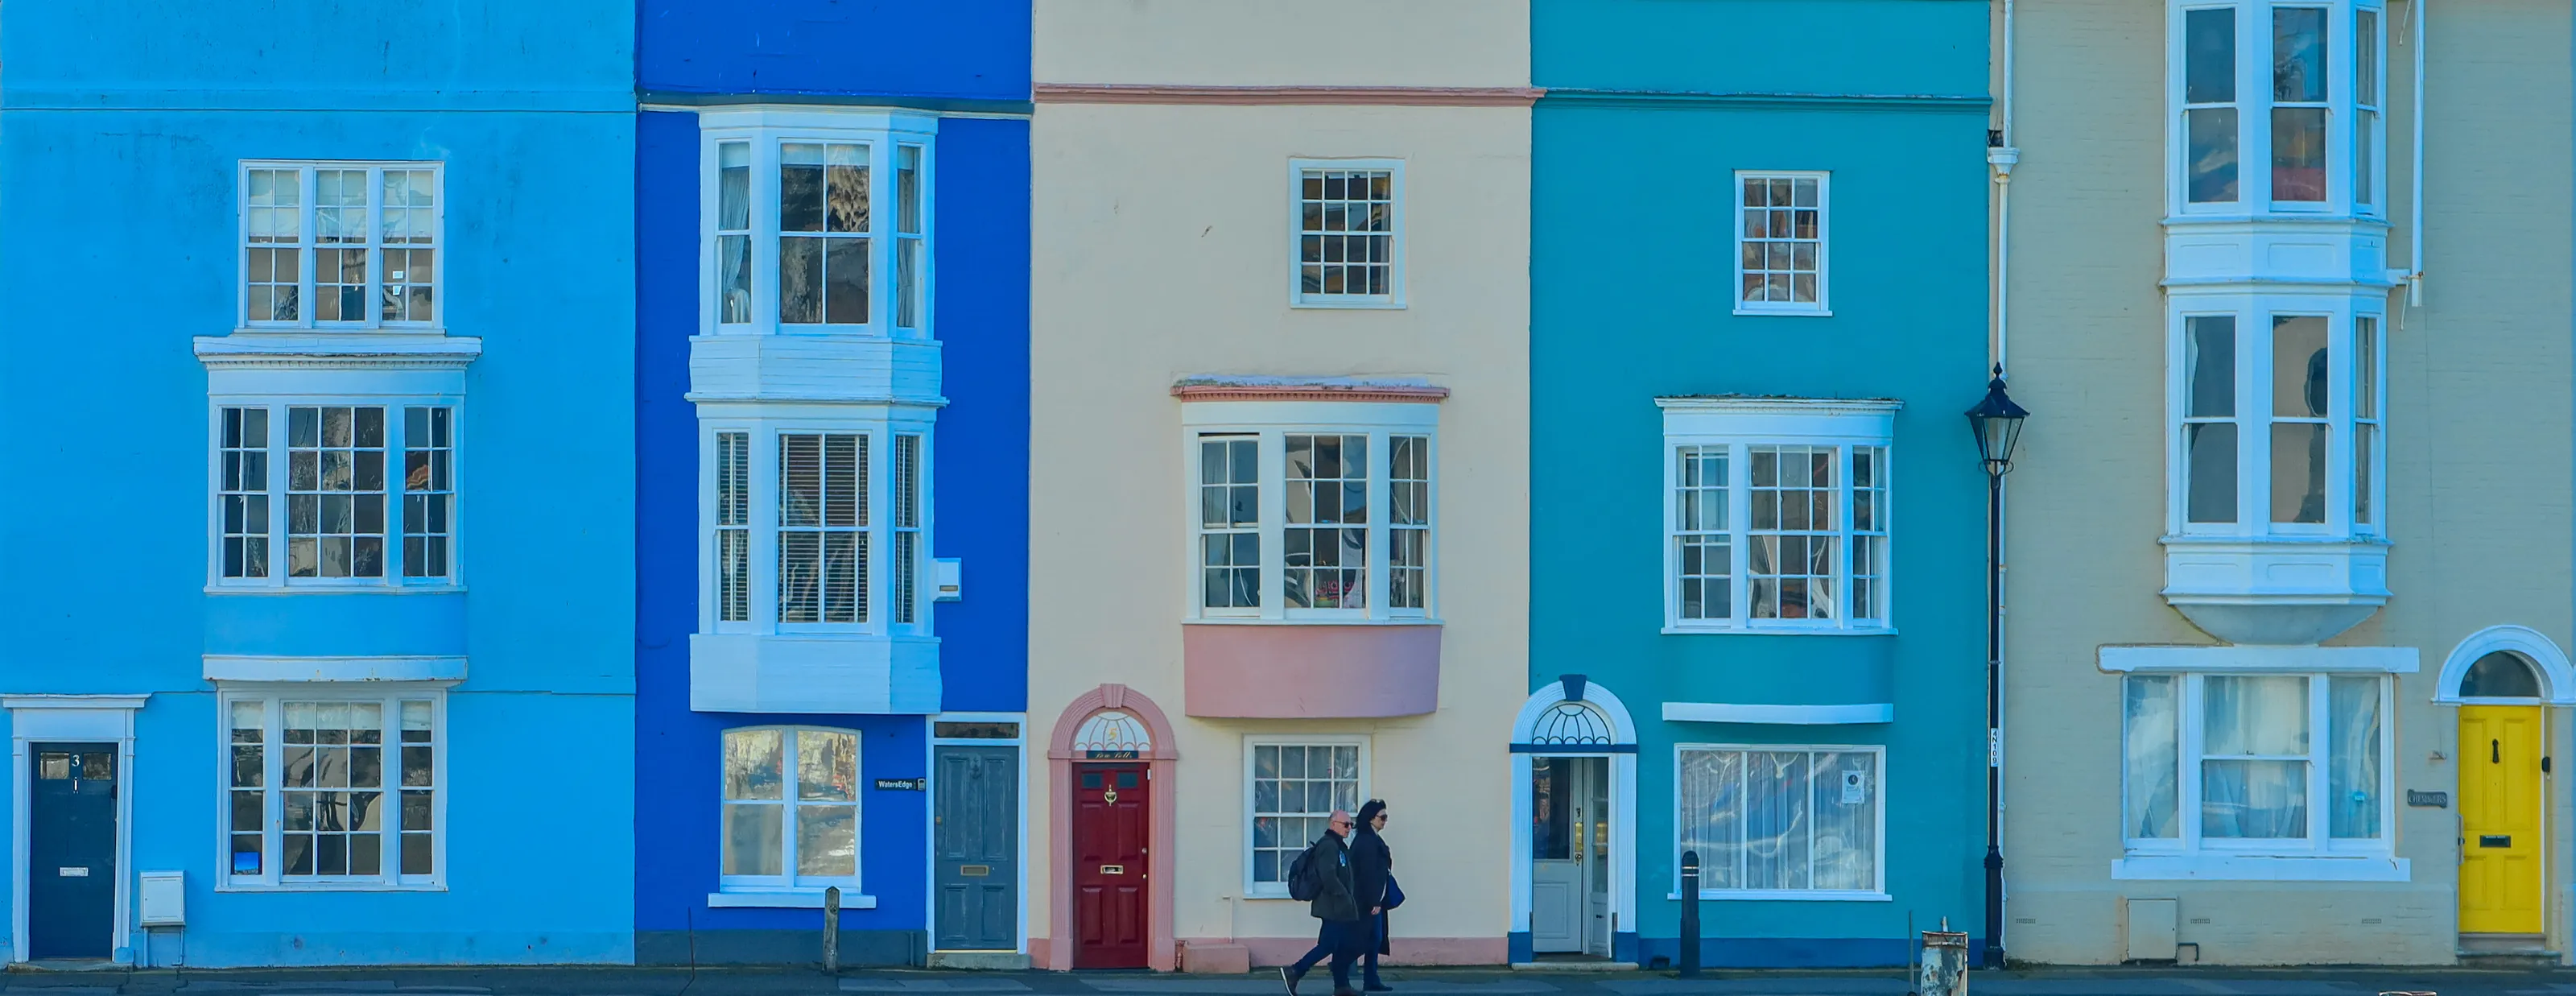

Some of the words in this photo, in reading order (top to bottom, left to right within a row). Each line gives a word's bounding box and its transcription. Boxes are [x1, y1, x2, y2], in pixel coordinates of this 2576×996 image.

[1108, 727, 1117, 741] 5
[71, 754, 80, 767] 3
[878, 780, 913, 789] WatersEdge
